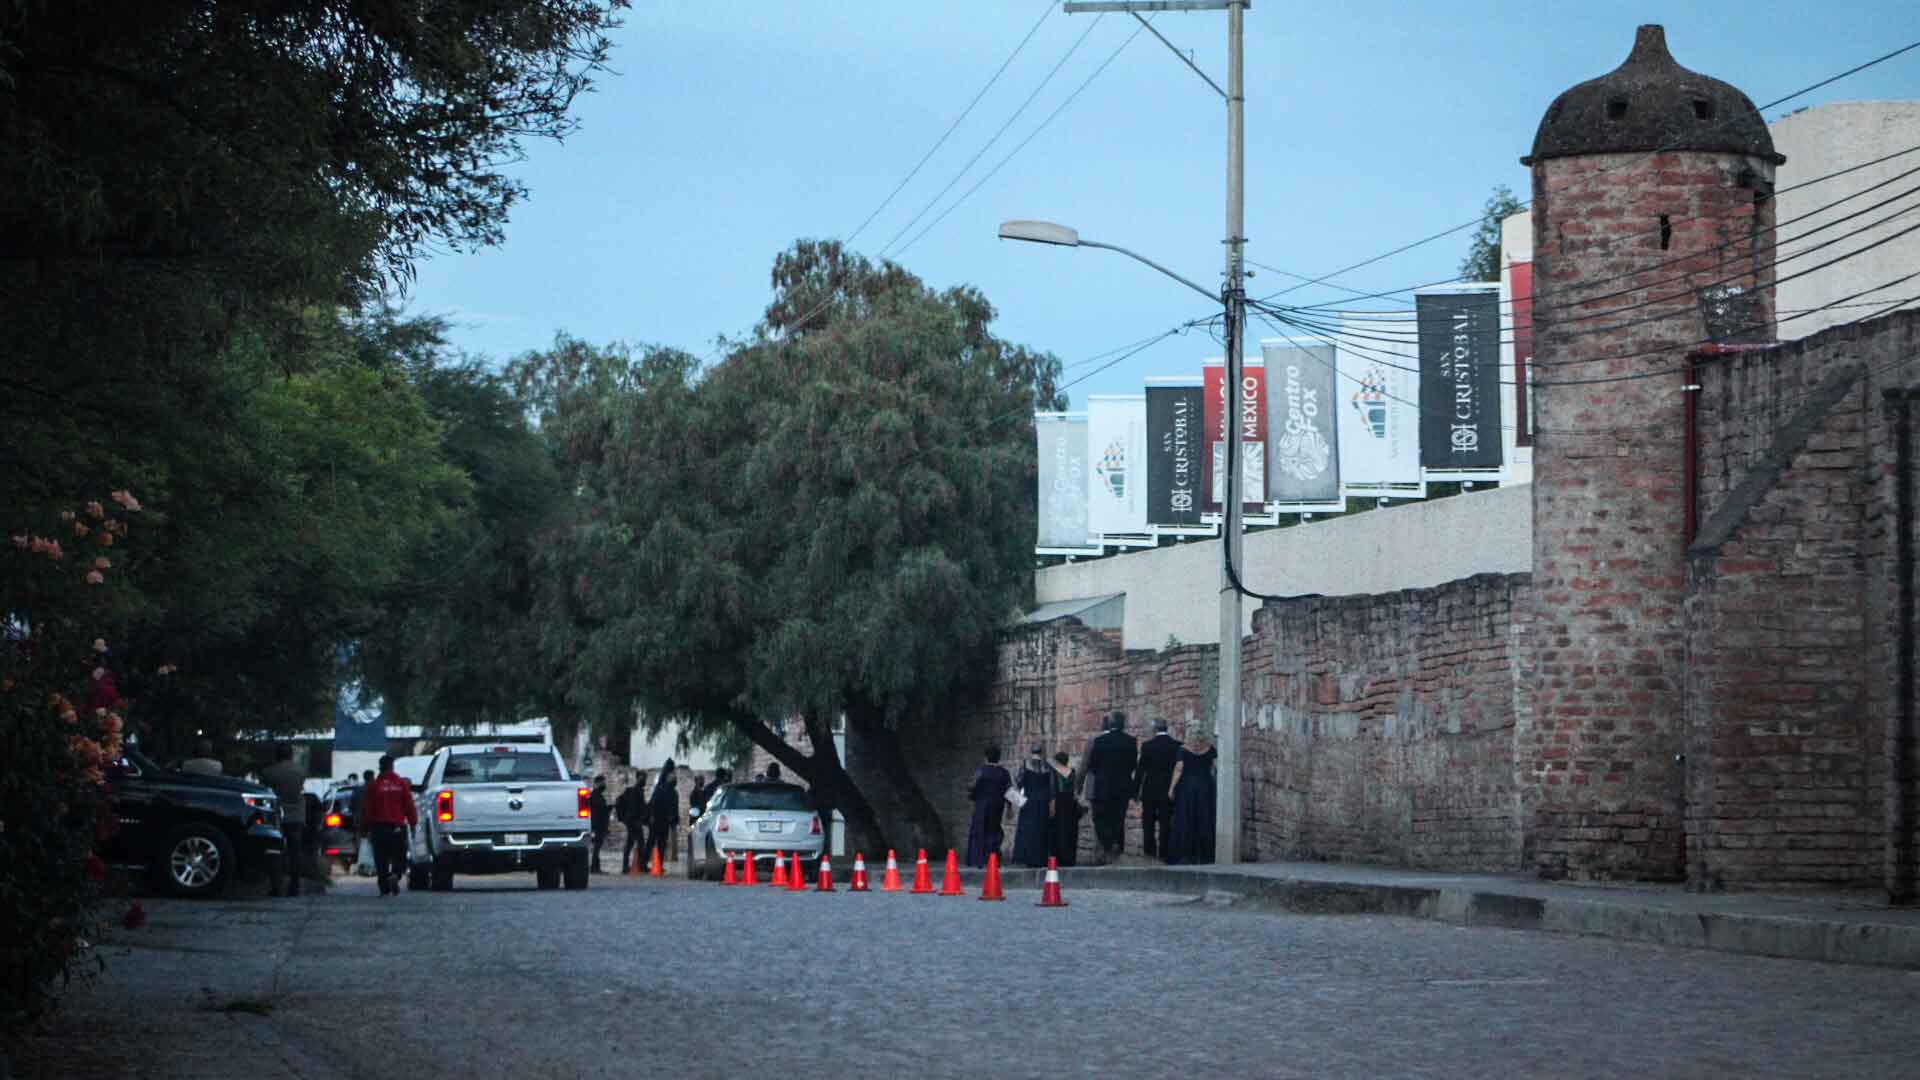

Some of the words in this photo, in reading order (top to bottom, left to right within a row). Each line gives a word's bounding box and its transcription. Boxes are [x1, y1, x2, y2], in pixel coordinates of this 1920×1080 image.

[1440, 351, 1450, 377] SAN
[1453, 308, 1472, 419] CRISTOBAL
[1242, 376, 1257, 438] MEXICO
[1285, 365, 1301, 434] Centro
[1163, 431, 1172, 453] SAN
[1174, 397, 1189, 486] CRISTOBAL
